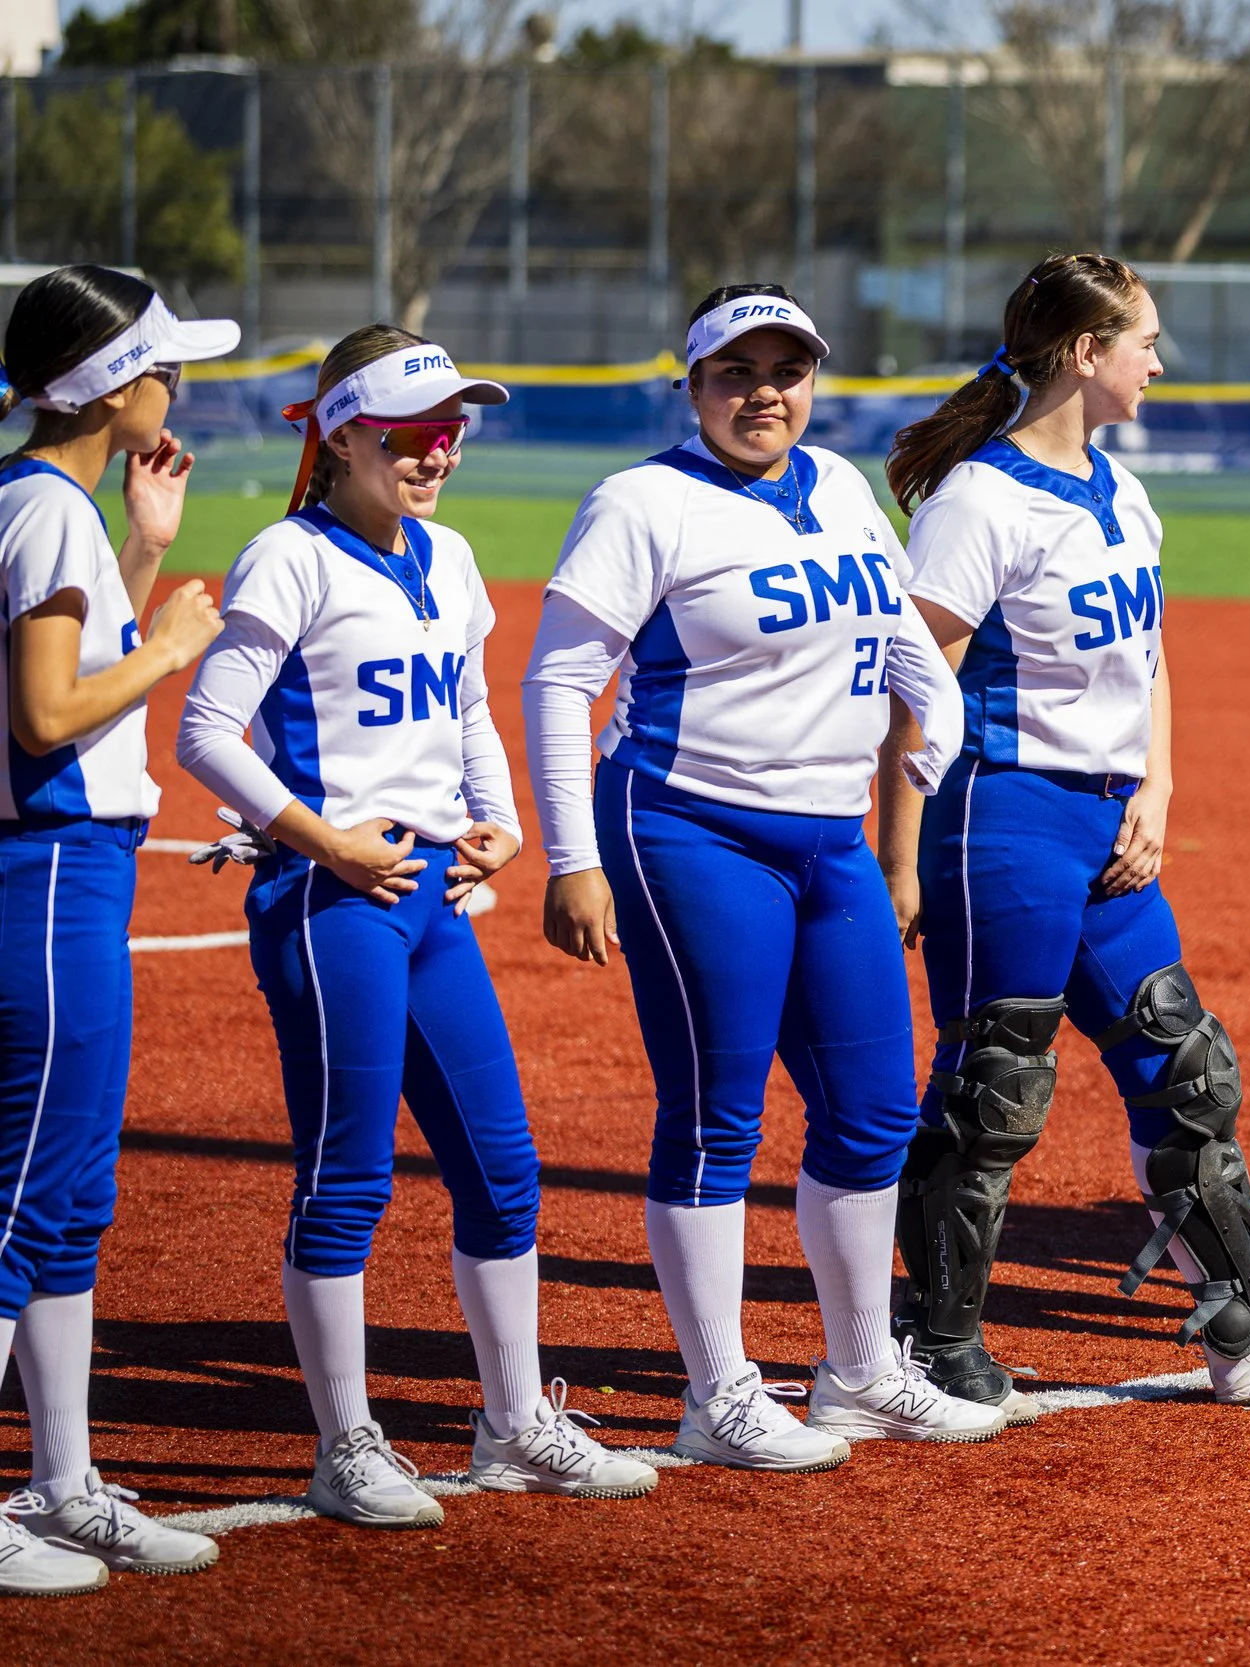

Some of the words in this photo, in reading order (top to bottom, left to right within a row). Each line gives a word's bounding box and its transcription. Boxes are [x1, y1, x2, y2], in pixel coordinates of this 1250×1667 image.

[729, 305, 792, 325] SMC
[107, 340, 153, 375] SOFTBALL
[326, 391, 361, 420] SOFTBALL
[748, 552, 902, 635] SMC
